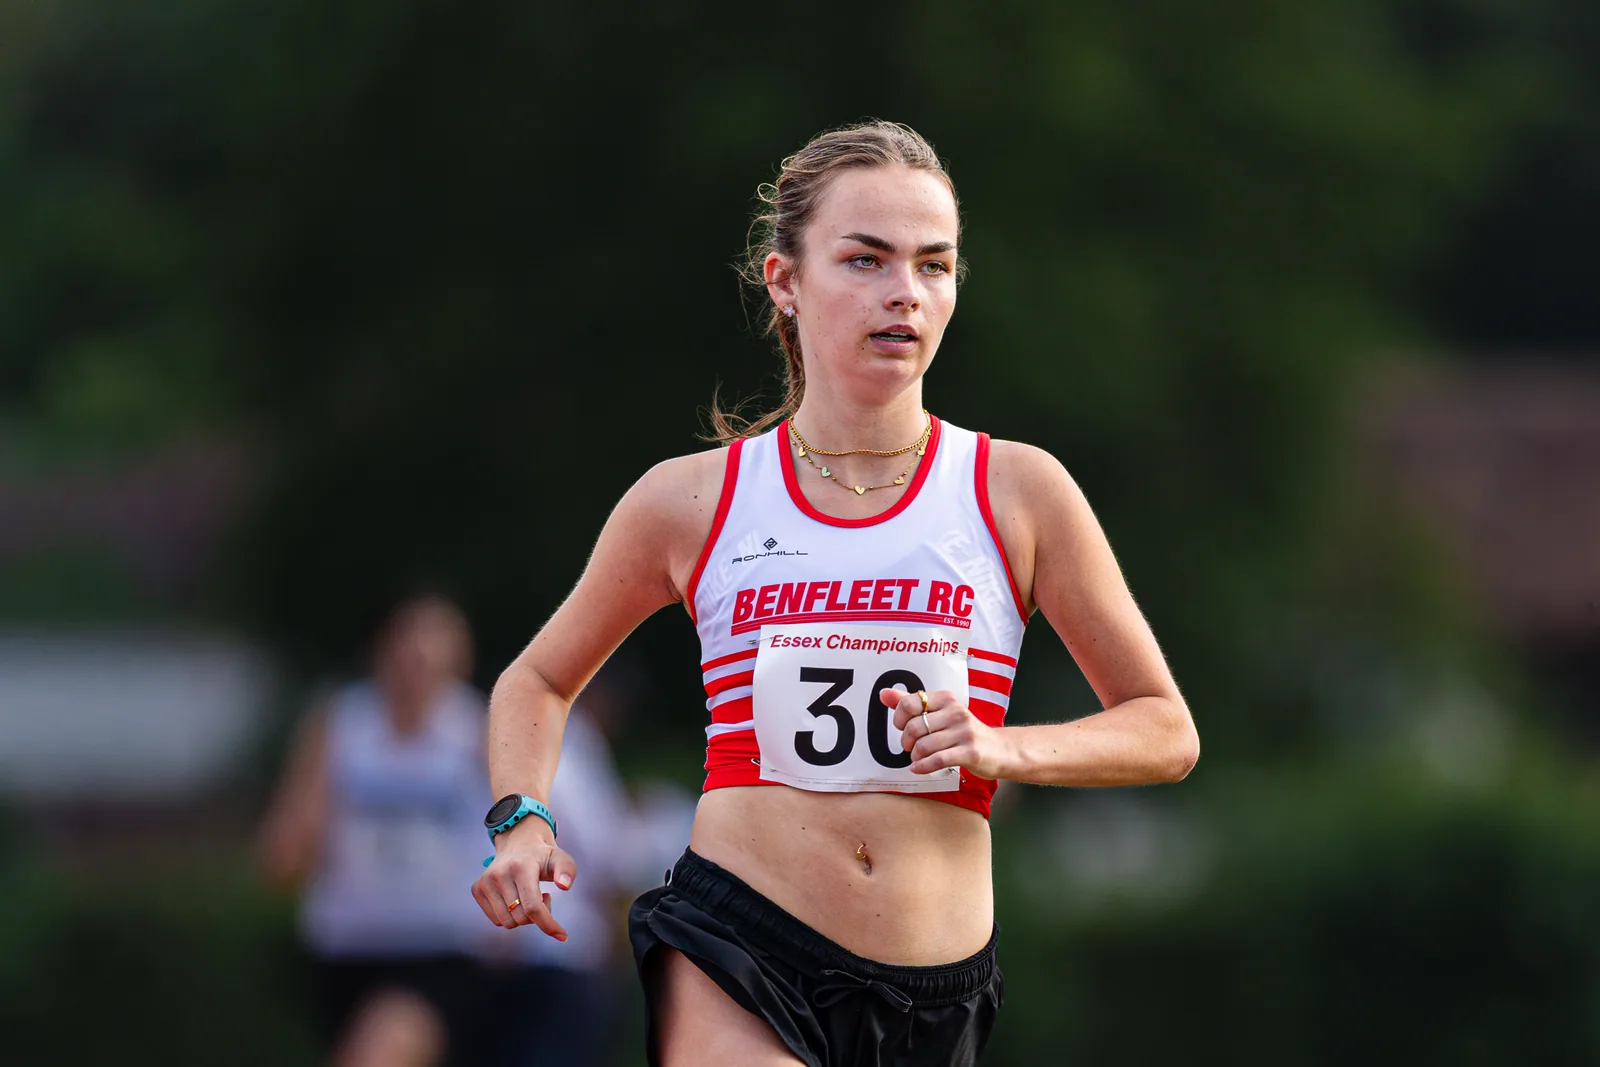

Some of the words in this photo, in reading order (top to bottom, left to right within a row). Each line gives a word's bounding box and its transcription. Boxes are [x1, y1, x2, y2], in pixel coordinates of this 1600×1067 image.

[731, 550, 809, 565] RONHILL
[732, 579, 920, 625] BENFLEET
[926, 580, 975, 617] RC
[943, 617, 955, 625] EST.
[956, 618, 970, 627] 1990
[770, 634, 824, 649] Essex
[826, 634, 960, 657] Championships
[794, 666, 928, 769] 30
